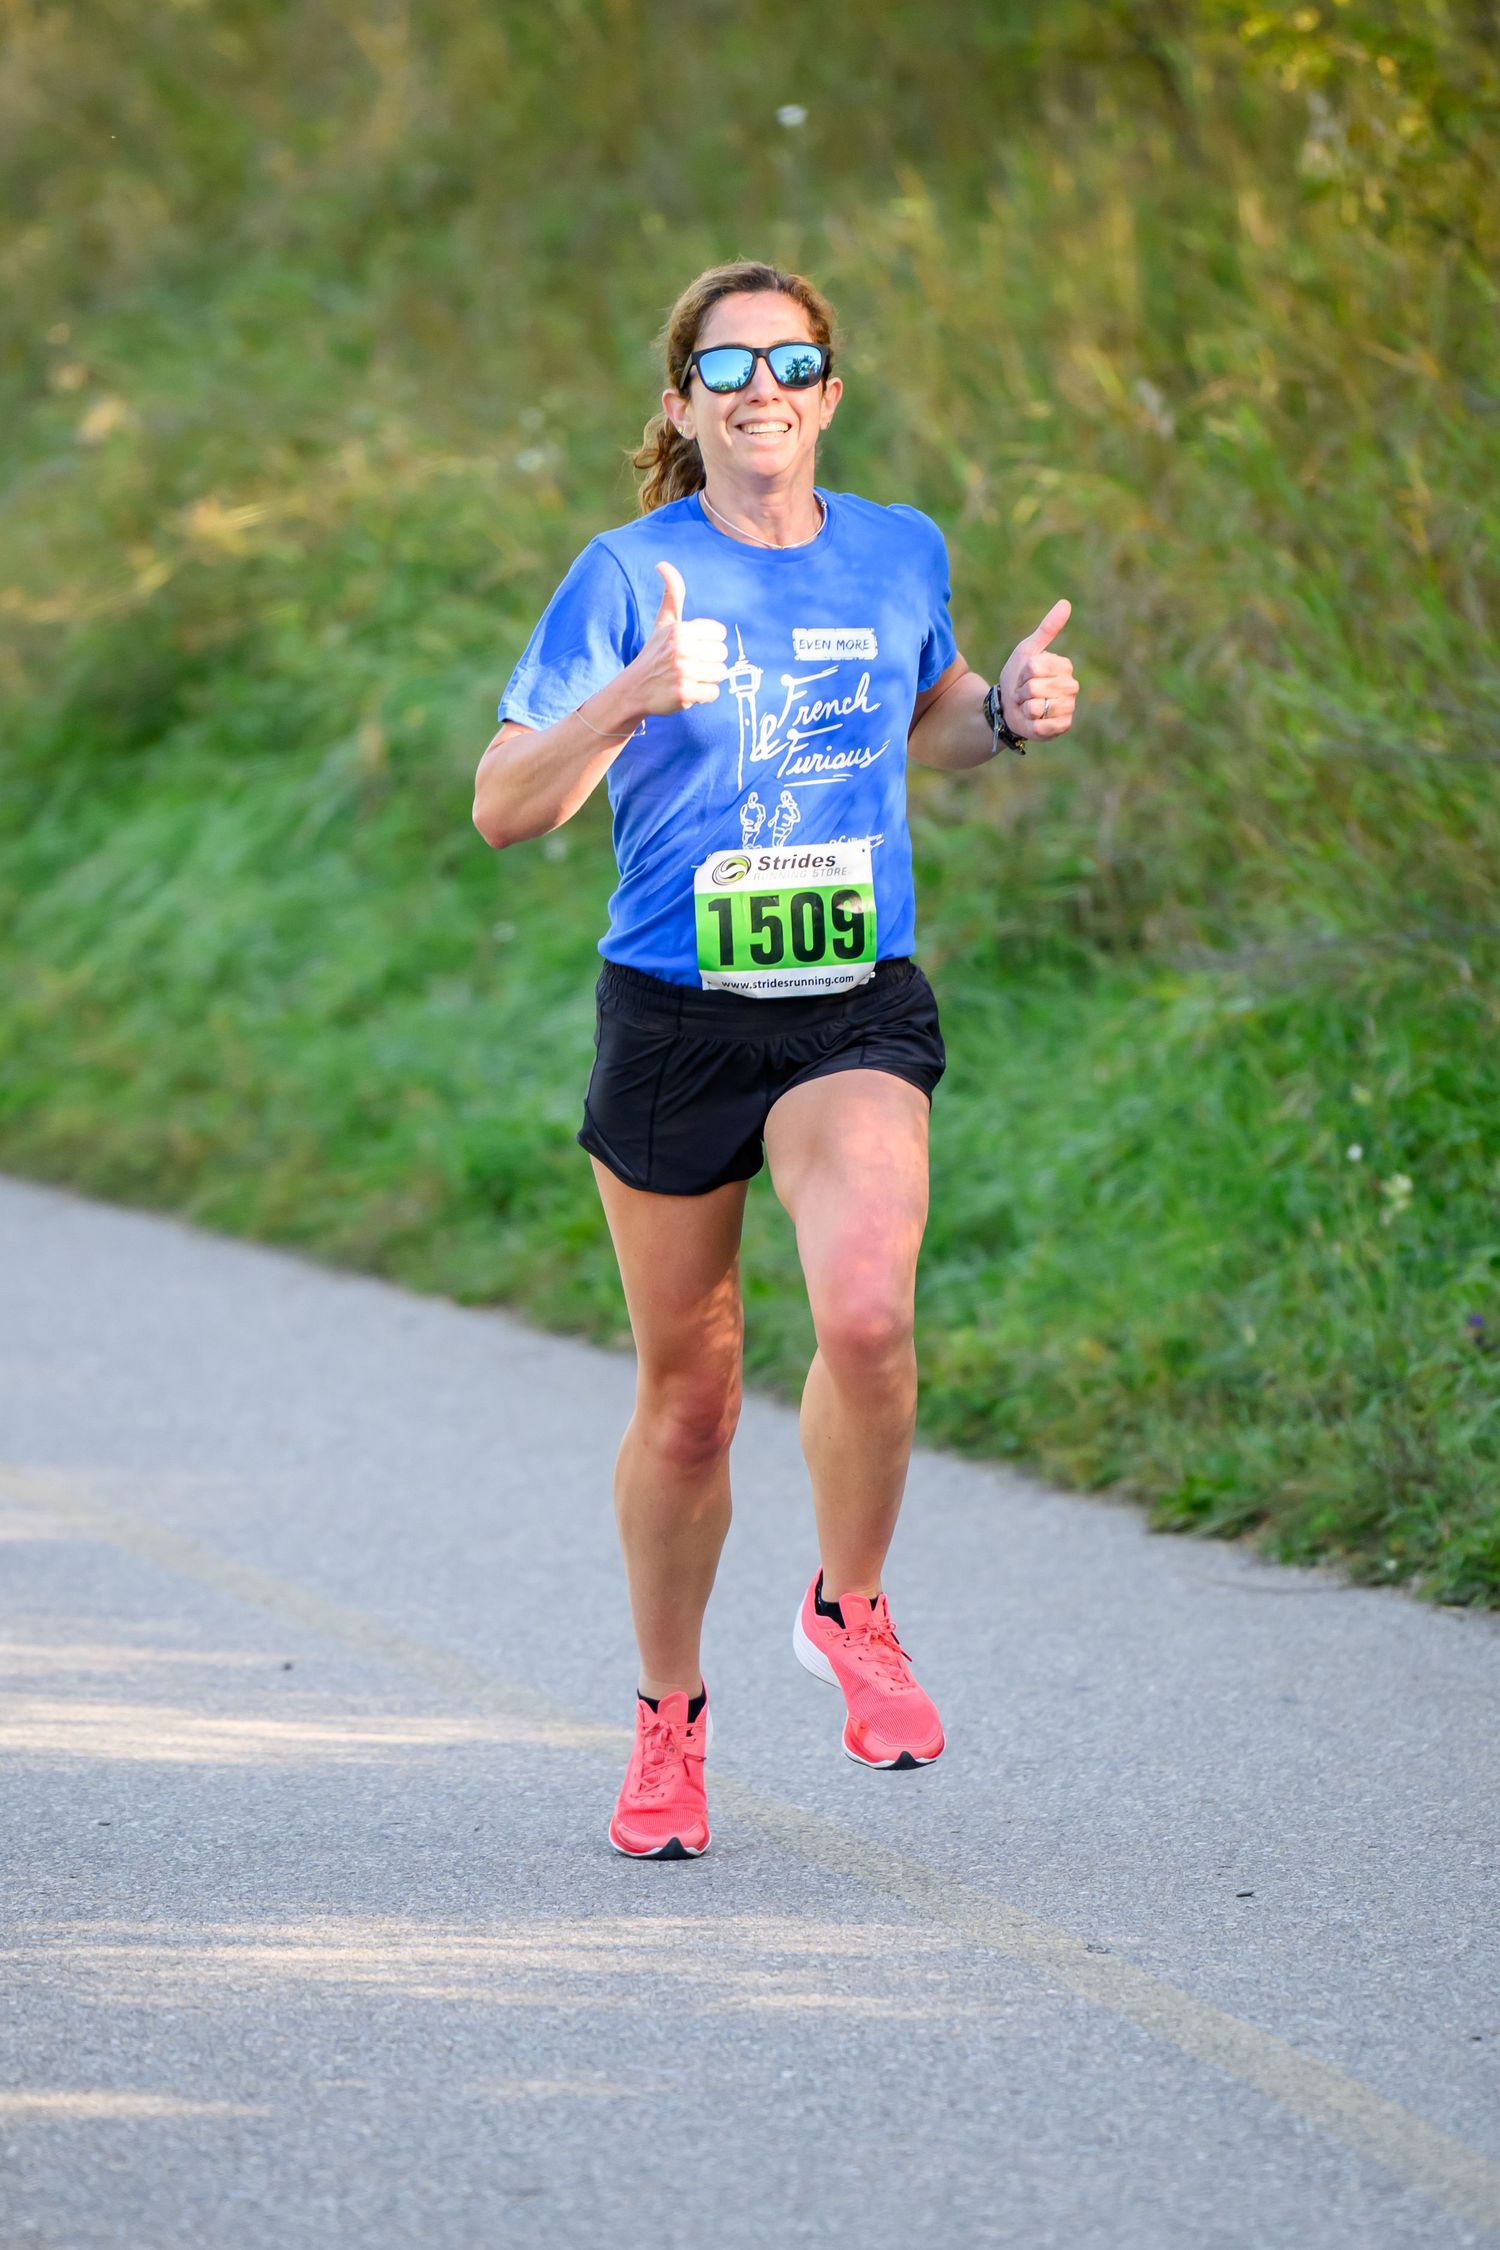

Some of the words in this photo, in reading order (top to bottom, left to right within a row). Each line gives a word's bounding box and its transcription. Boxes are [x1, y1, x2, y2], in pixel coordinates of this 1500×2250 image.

[799, 639, 831, 650] EVEN
[836, 639, 870, 651] MORE
[777, 665, 881, 728] French
[777, 724, 890, 779] Furious
[757, 853, 836, 871] Strides
[812, 866, 848, 879] STORE
[708, 889, 866, 966] 1509
[721, 975, 854, 989] www.stridesrunning.com
